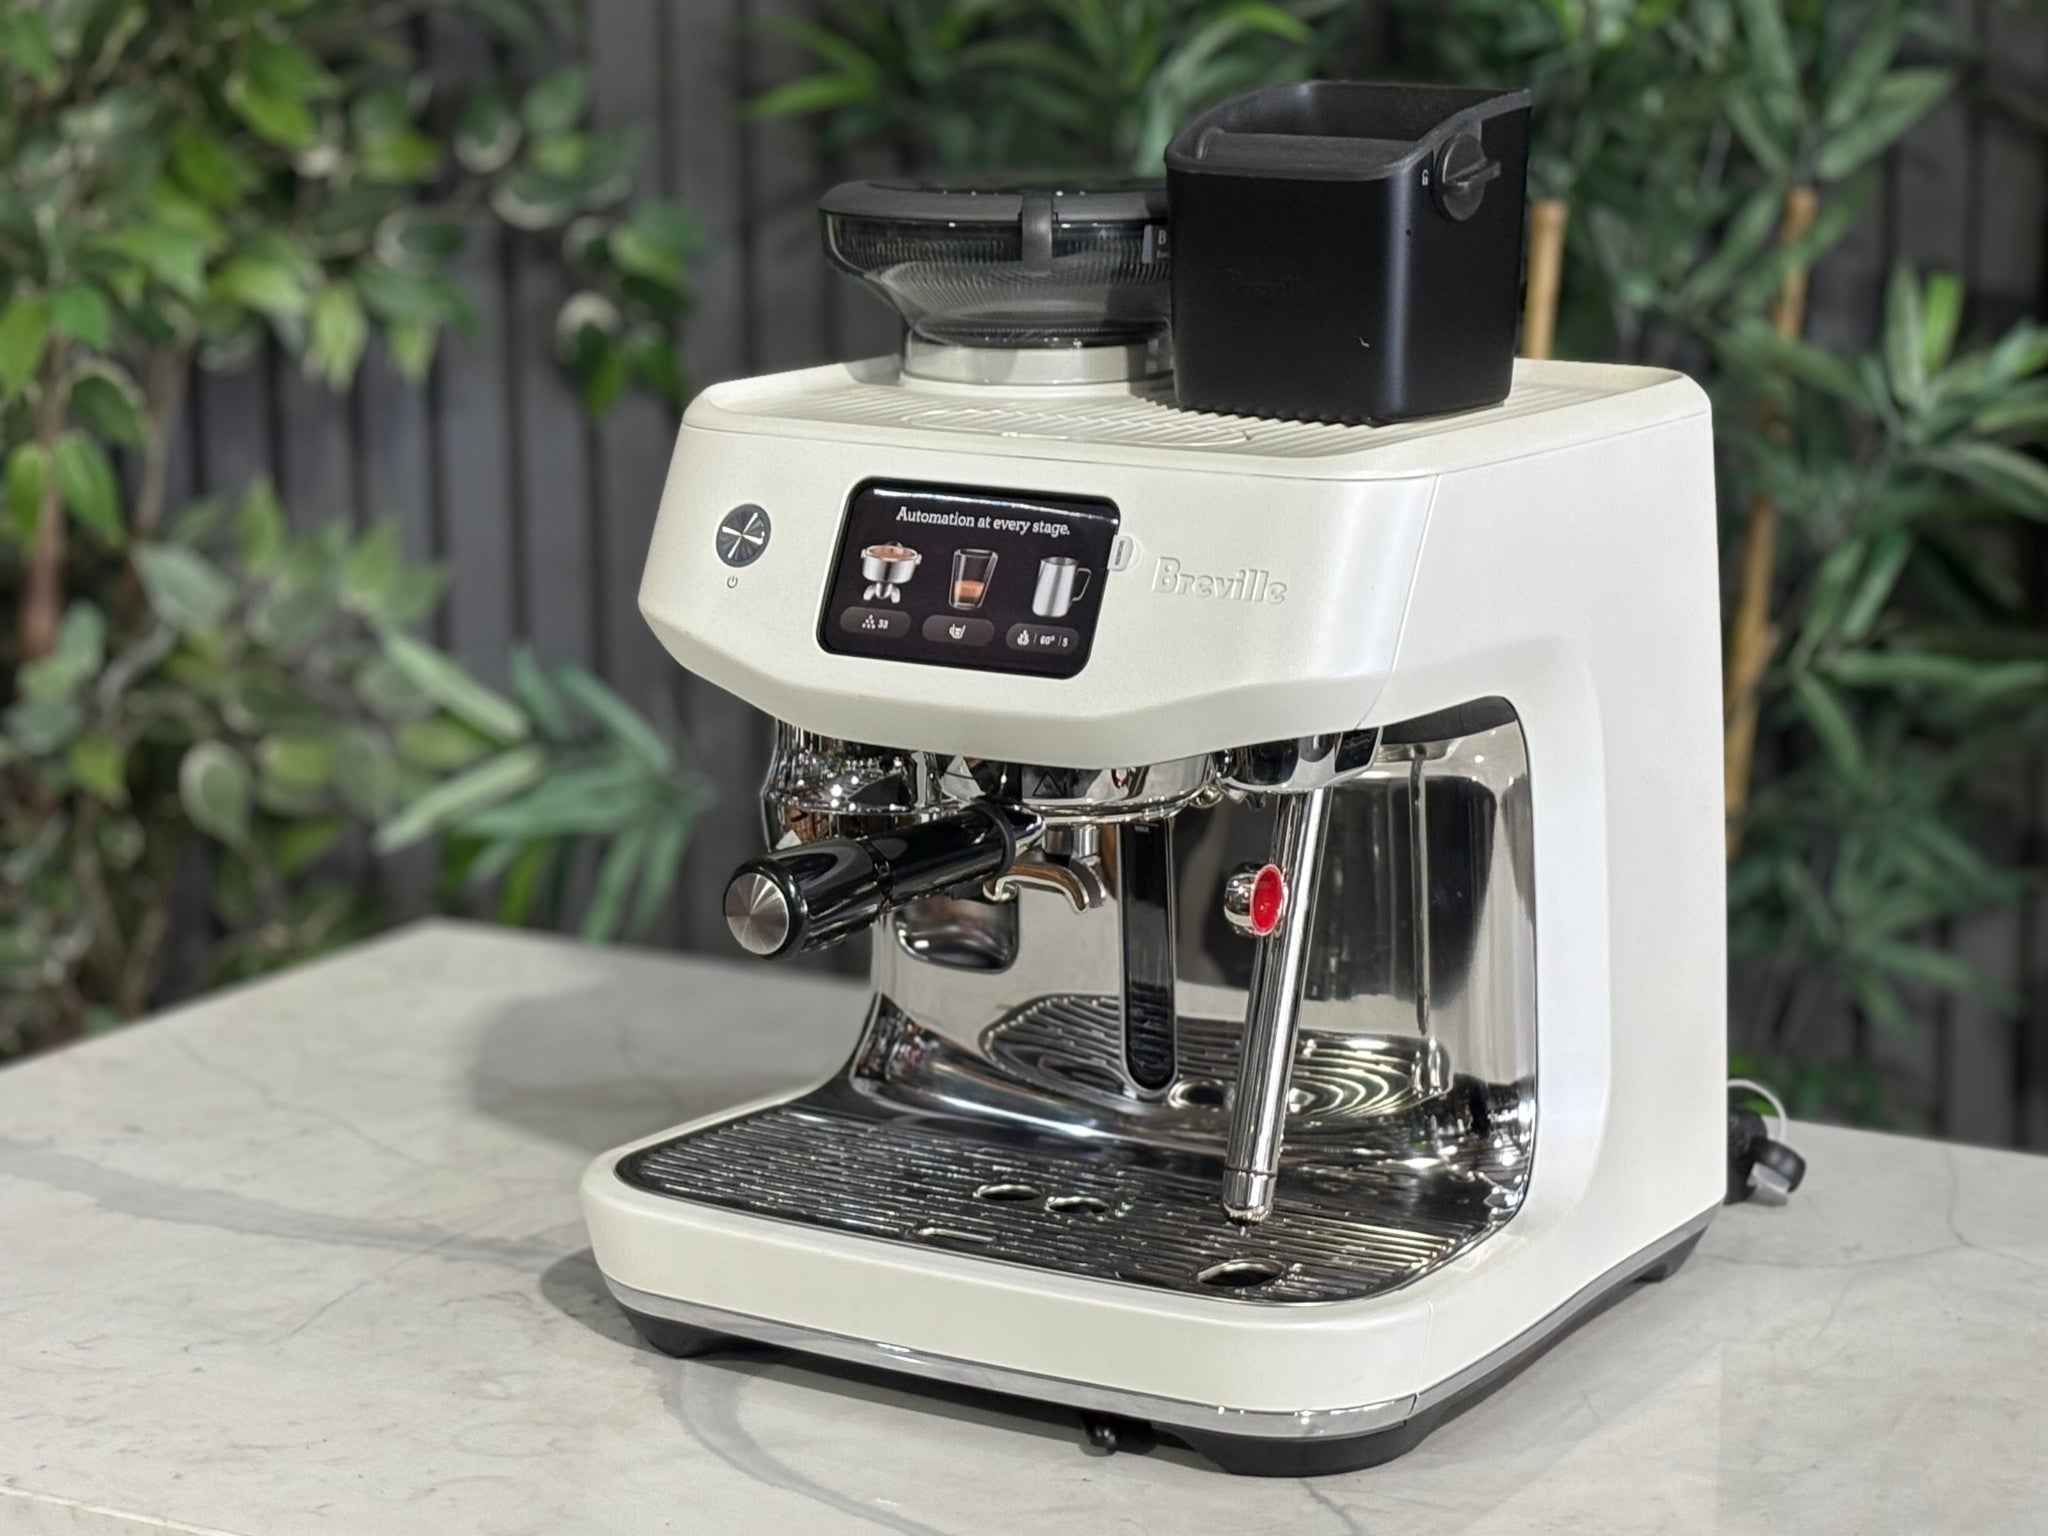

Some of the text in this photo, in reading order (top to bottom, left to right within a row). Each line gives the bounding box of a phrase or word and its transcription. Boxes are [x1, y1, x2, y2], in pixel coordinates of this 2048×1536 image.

[895, 506, 1071, 538] Automation at every stage.
[1151, 556, 1288, 605] Breville
